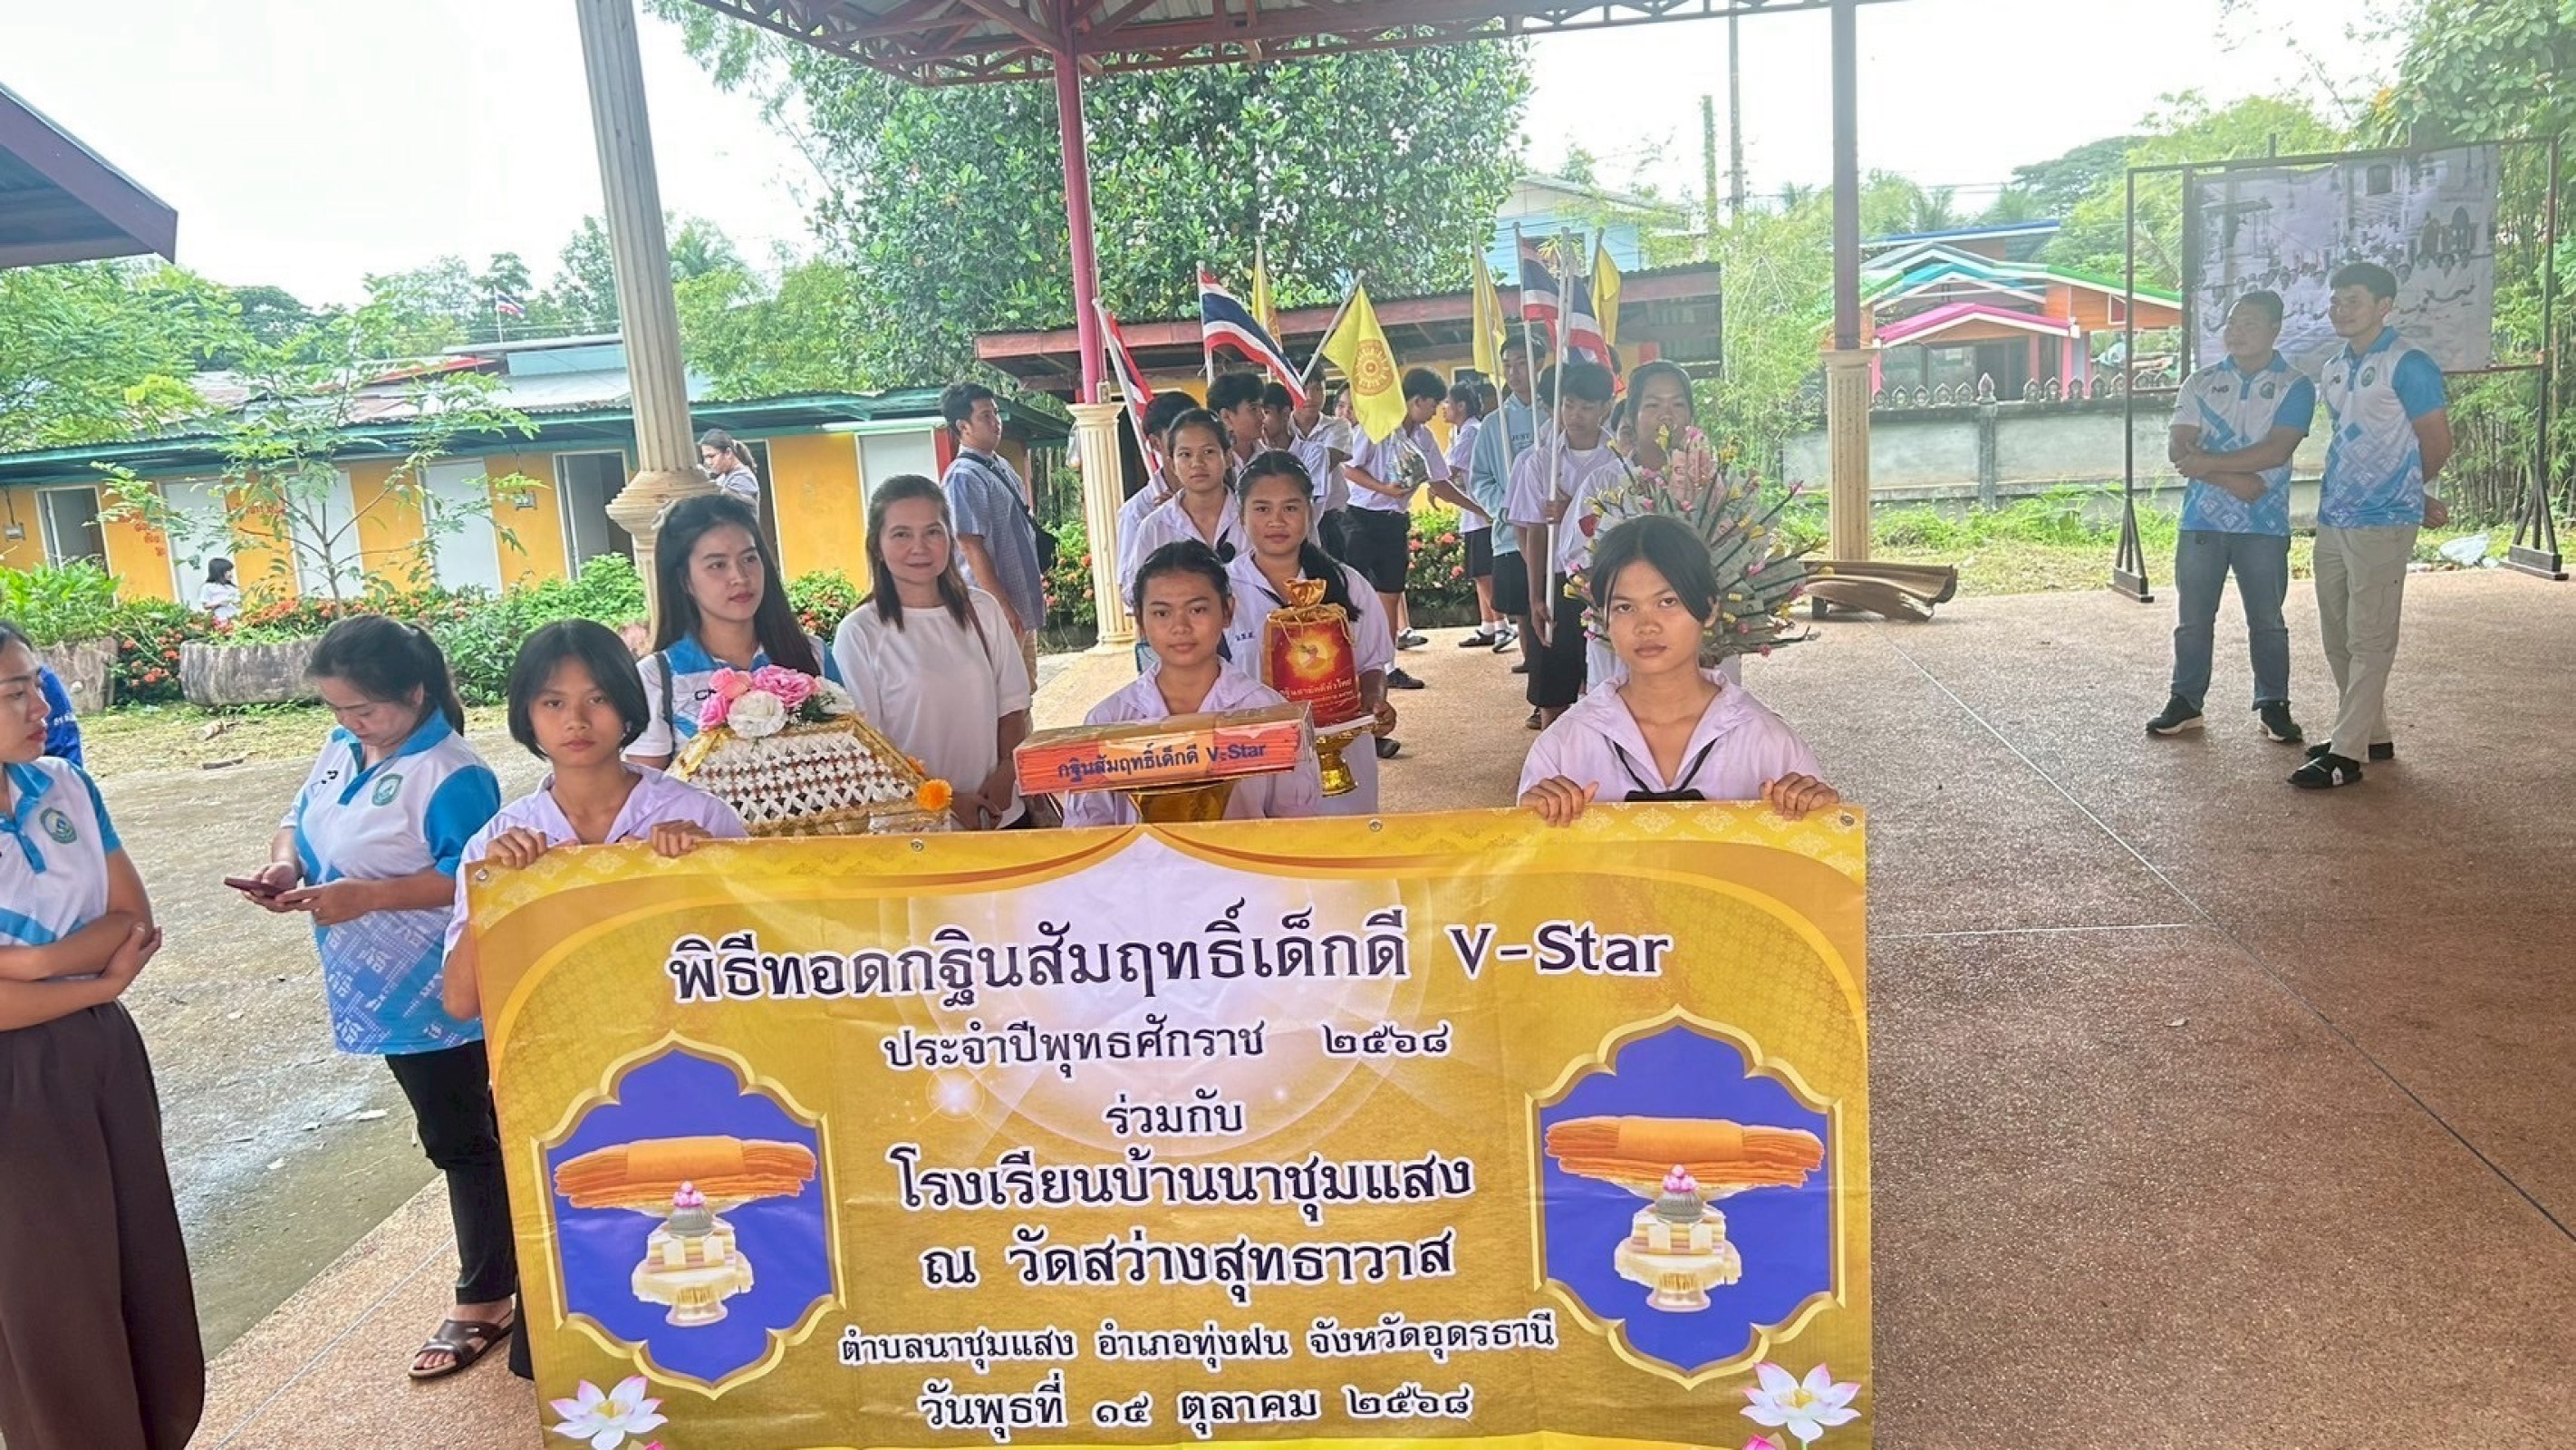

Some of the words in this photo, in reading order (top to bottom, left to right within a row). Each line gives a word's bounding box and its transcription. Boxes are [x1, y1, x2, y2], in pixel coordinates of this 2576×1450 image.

[1057, 742, 1199, 783] กฐินสัมฤทธิ์เด็กดี
[669, 895, 1407, 1008] พิธีทอดกฐินสัมฤทธิ์เด็กดี
[1450, 923, 1671, 976] V-Star
[883, 1012, 1266, 1079] ประจำปีพุทธศักราช
[1322, 1023, 1451, 1056] ๒๕๖๘
[1105, 1088, 1244, 1136] ร่วมกับ
[889, 1145, 1473, 1223] โรงเรียนบ้านนาชุมแสง
[922, 1249, 978, 1285] ณ
[1008, 1227, 1454, 1302] วัดสว่างสุทธาวาส
[841, 1328, 1075, 1369] ตำบลนาชุมแสง
[1097, 1321, 1289, 1369] อำเภอทุ่งฝน
[1309, 1311, 1556, 1361] จังหวัดอุดรธานี
[921, 1371, 1064, 1440] วันพุธที่
[1095, 1395, 1150, 1424] ๑๕
[1181, 1392, 1318, 1436] ตุลาคม
[1346, 1384, 1472, 1416] ๒๕๖๘
